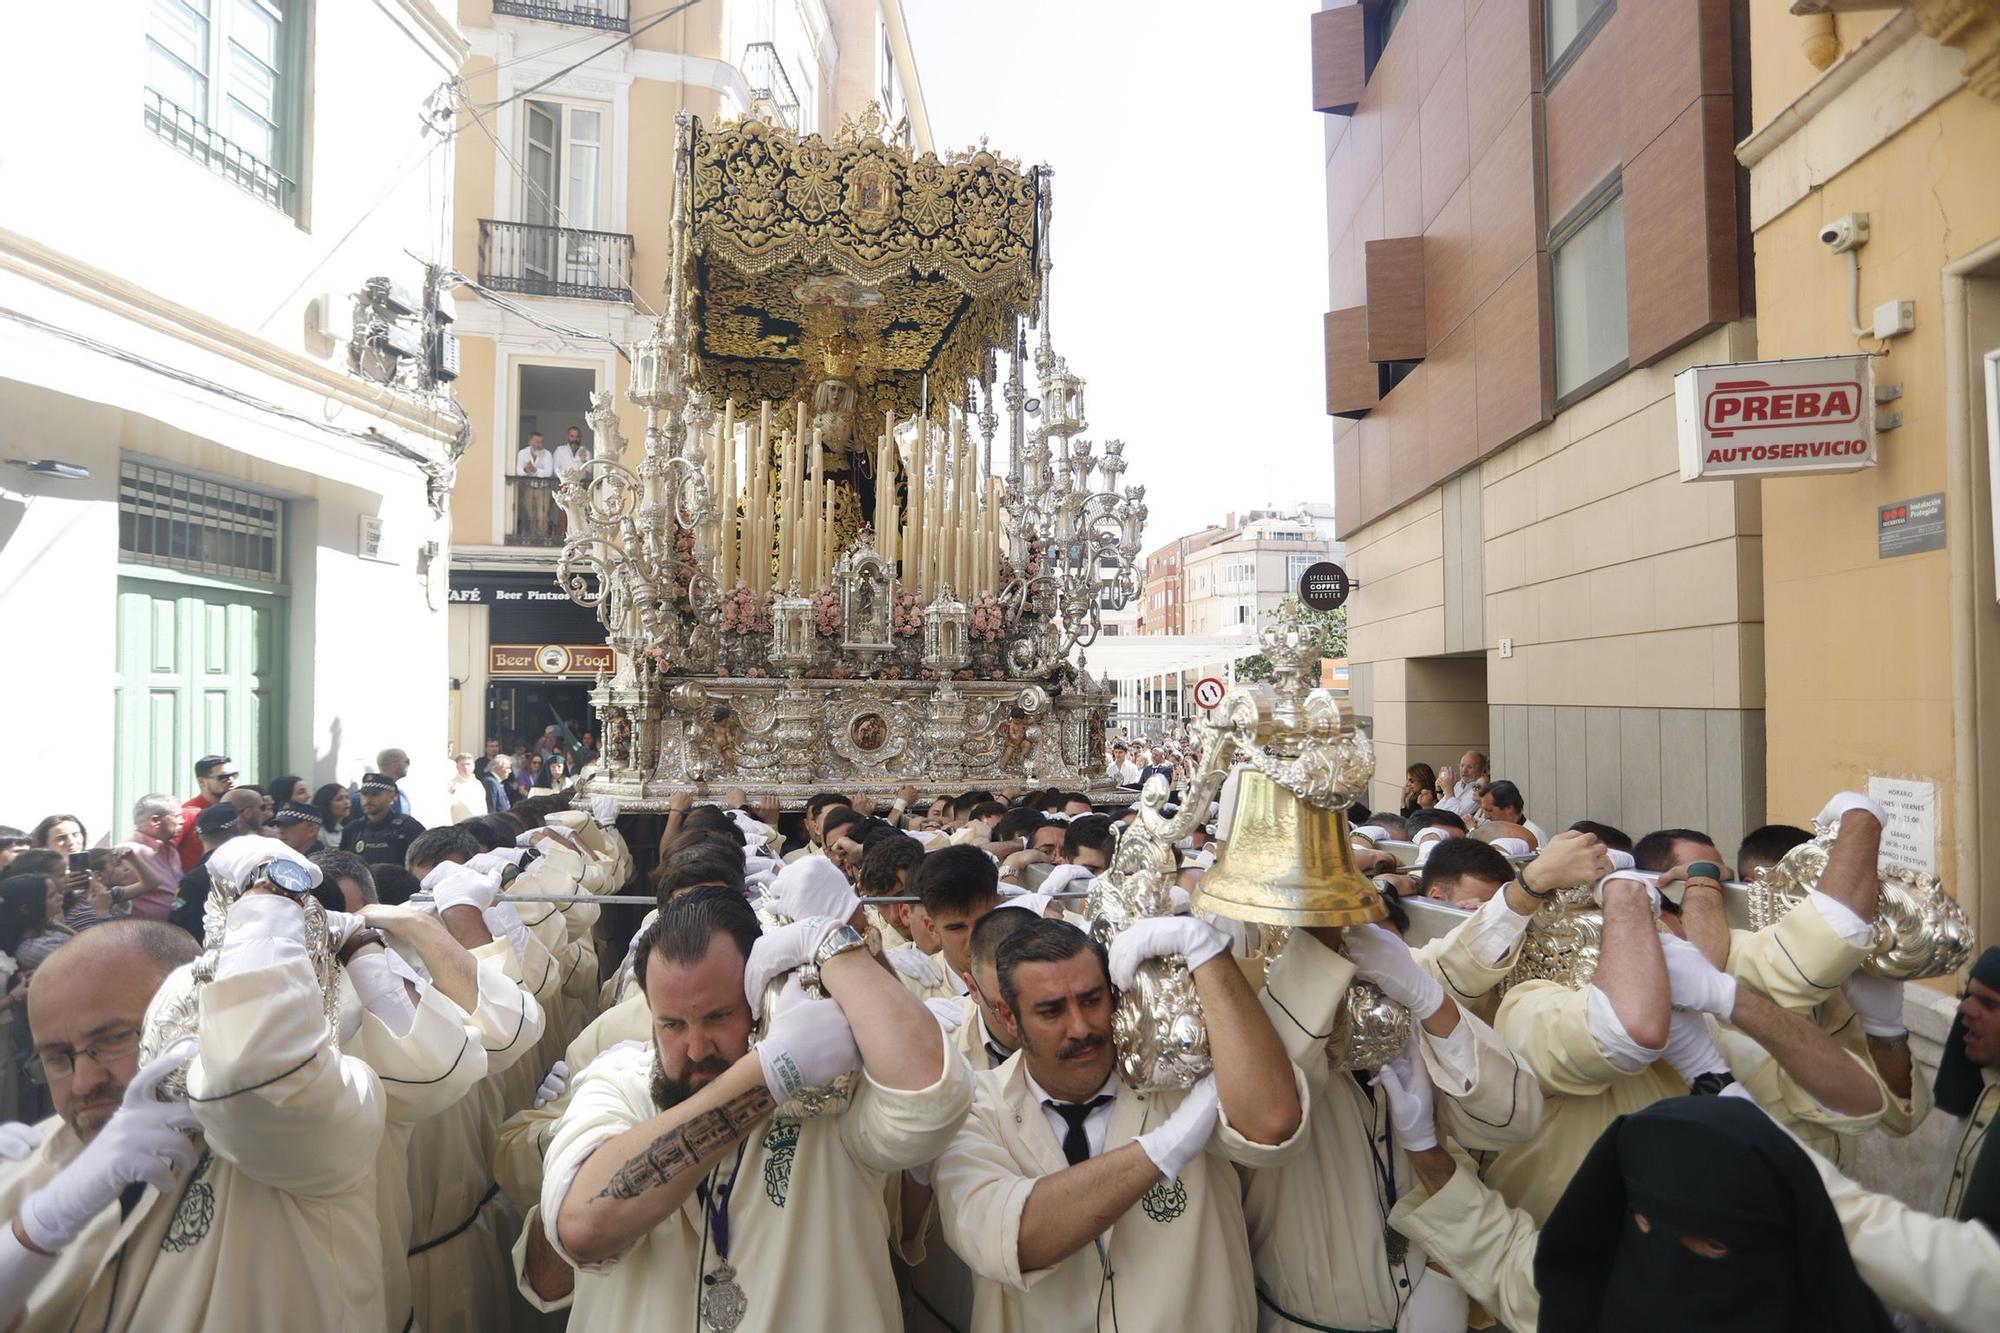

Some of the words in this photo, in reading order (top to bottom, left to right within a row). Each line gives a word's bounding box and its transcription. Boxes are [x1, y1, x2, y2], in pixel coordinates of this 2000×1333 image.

[1714, 391, 1851, 423] PREBA
[1707, 439, 1867, 463] AUTOSERVICIO
[1910, 507, 1938, 518] Protegida
[448, 588, 481, 601] AFÉ
[496, 590, 523, 600] Beer
[527, 591, 570, 600] Pintxos
[496, 654, 532, 666] Beer
[576, 655, 610, 666] Food
[1888, 789, 1913, 798] HORARIO
[1901, 801, 1925, 811] VIERNES
[1878, 849, 1899, 861] OMINGO
